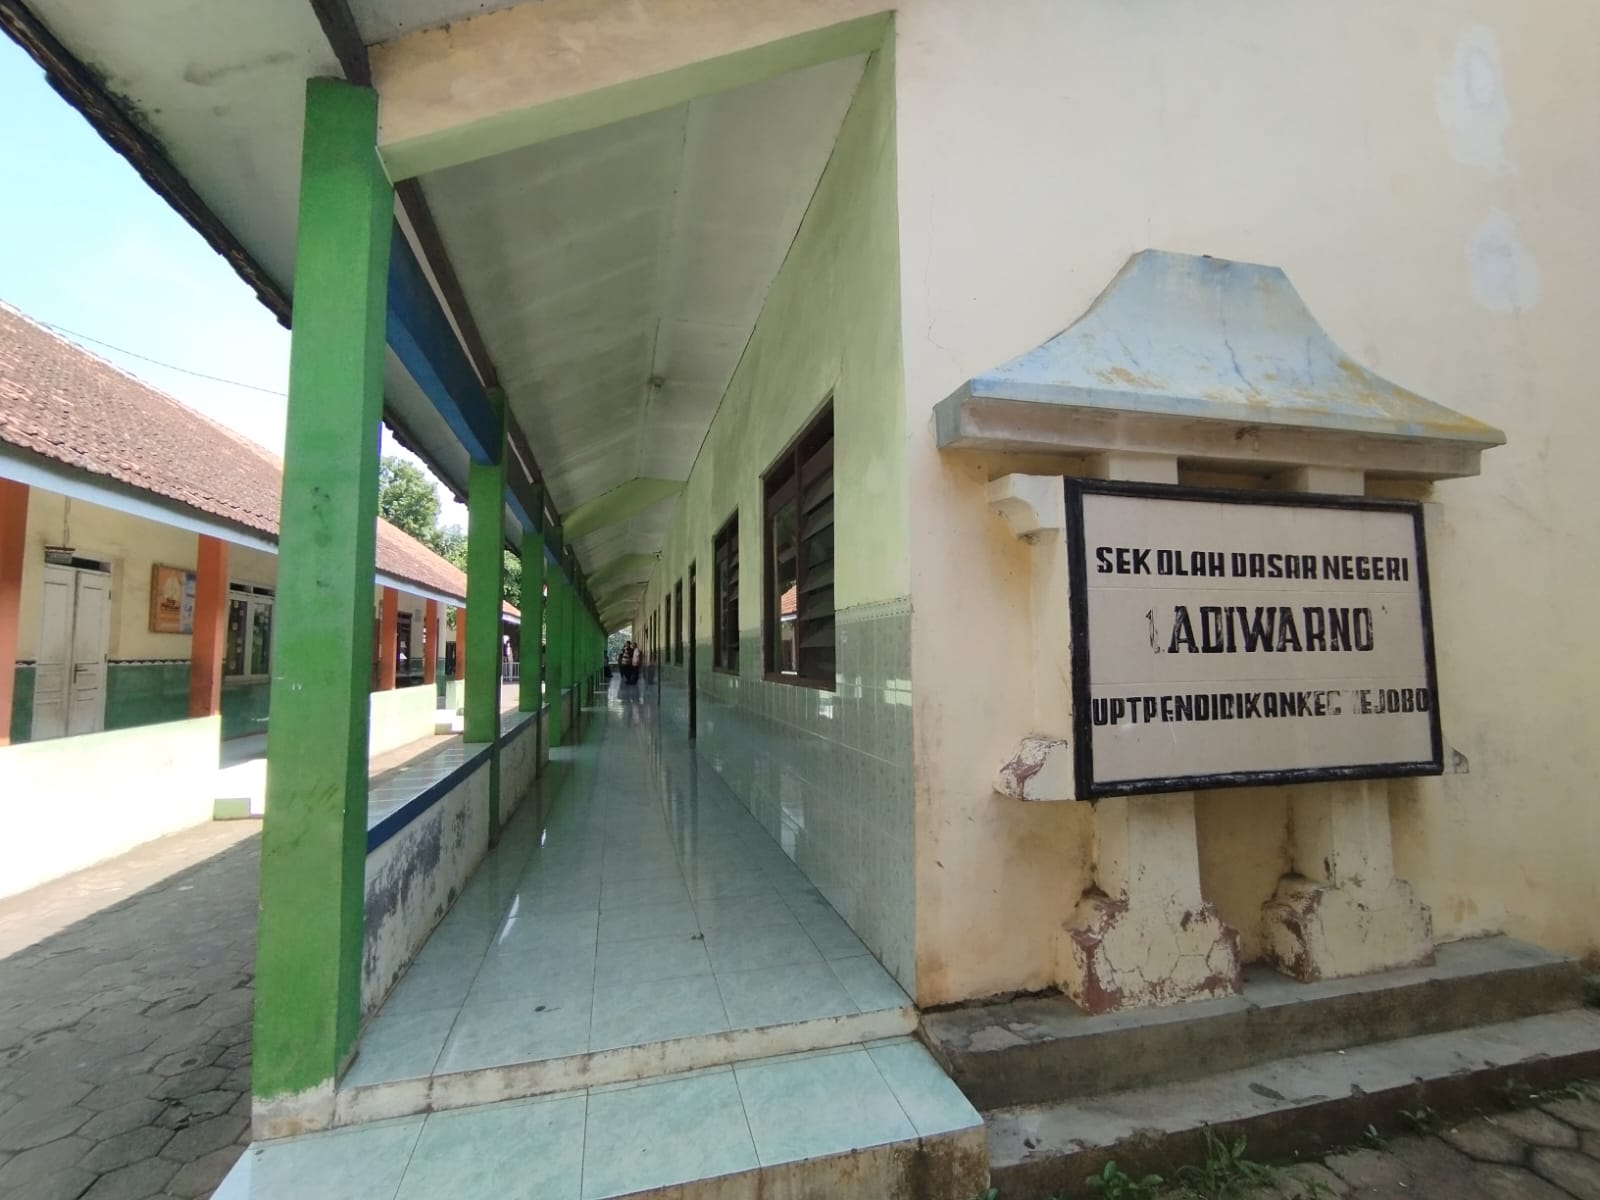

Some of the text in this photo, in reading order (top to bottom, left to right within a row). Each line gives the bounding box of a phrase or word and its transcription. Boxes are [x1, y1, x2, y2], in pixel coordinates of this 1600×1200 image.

[1096, 546, 1409, 581] SEKOLAH DASAR NEGERI
[1167, 605, 1374, 653] ADIWARNO
[1092, 696, 1142, 726] UPT
[1143, 690, 1297, 723] PENDIDIKAN
